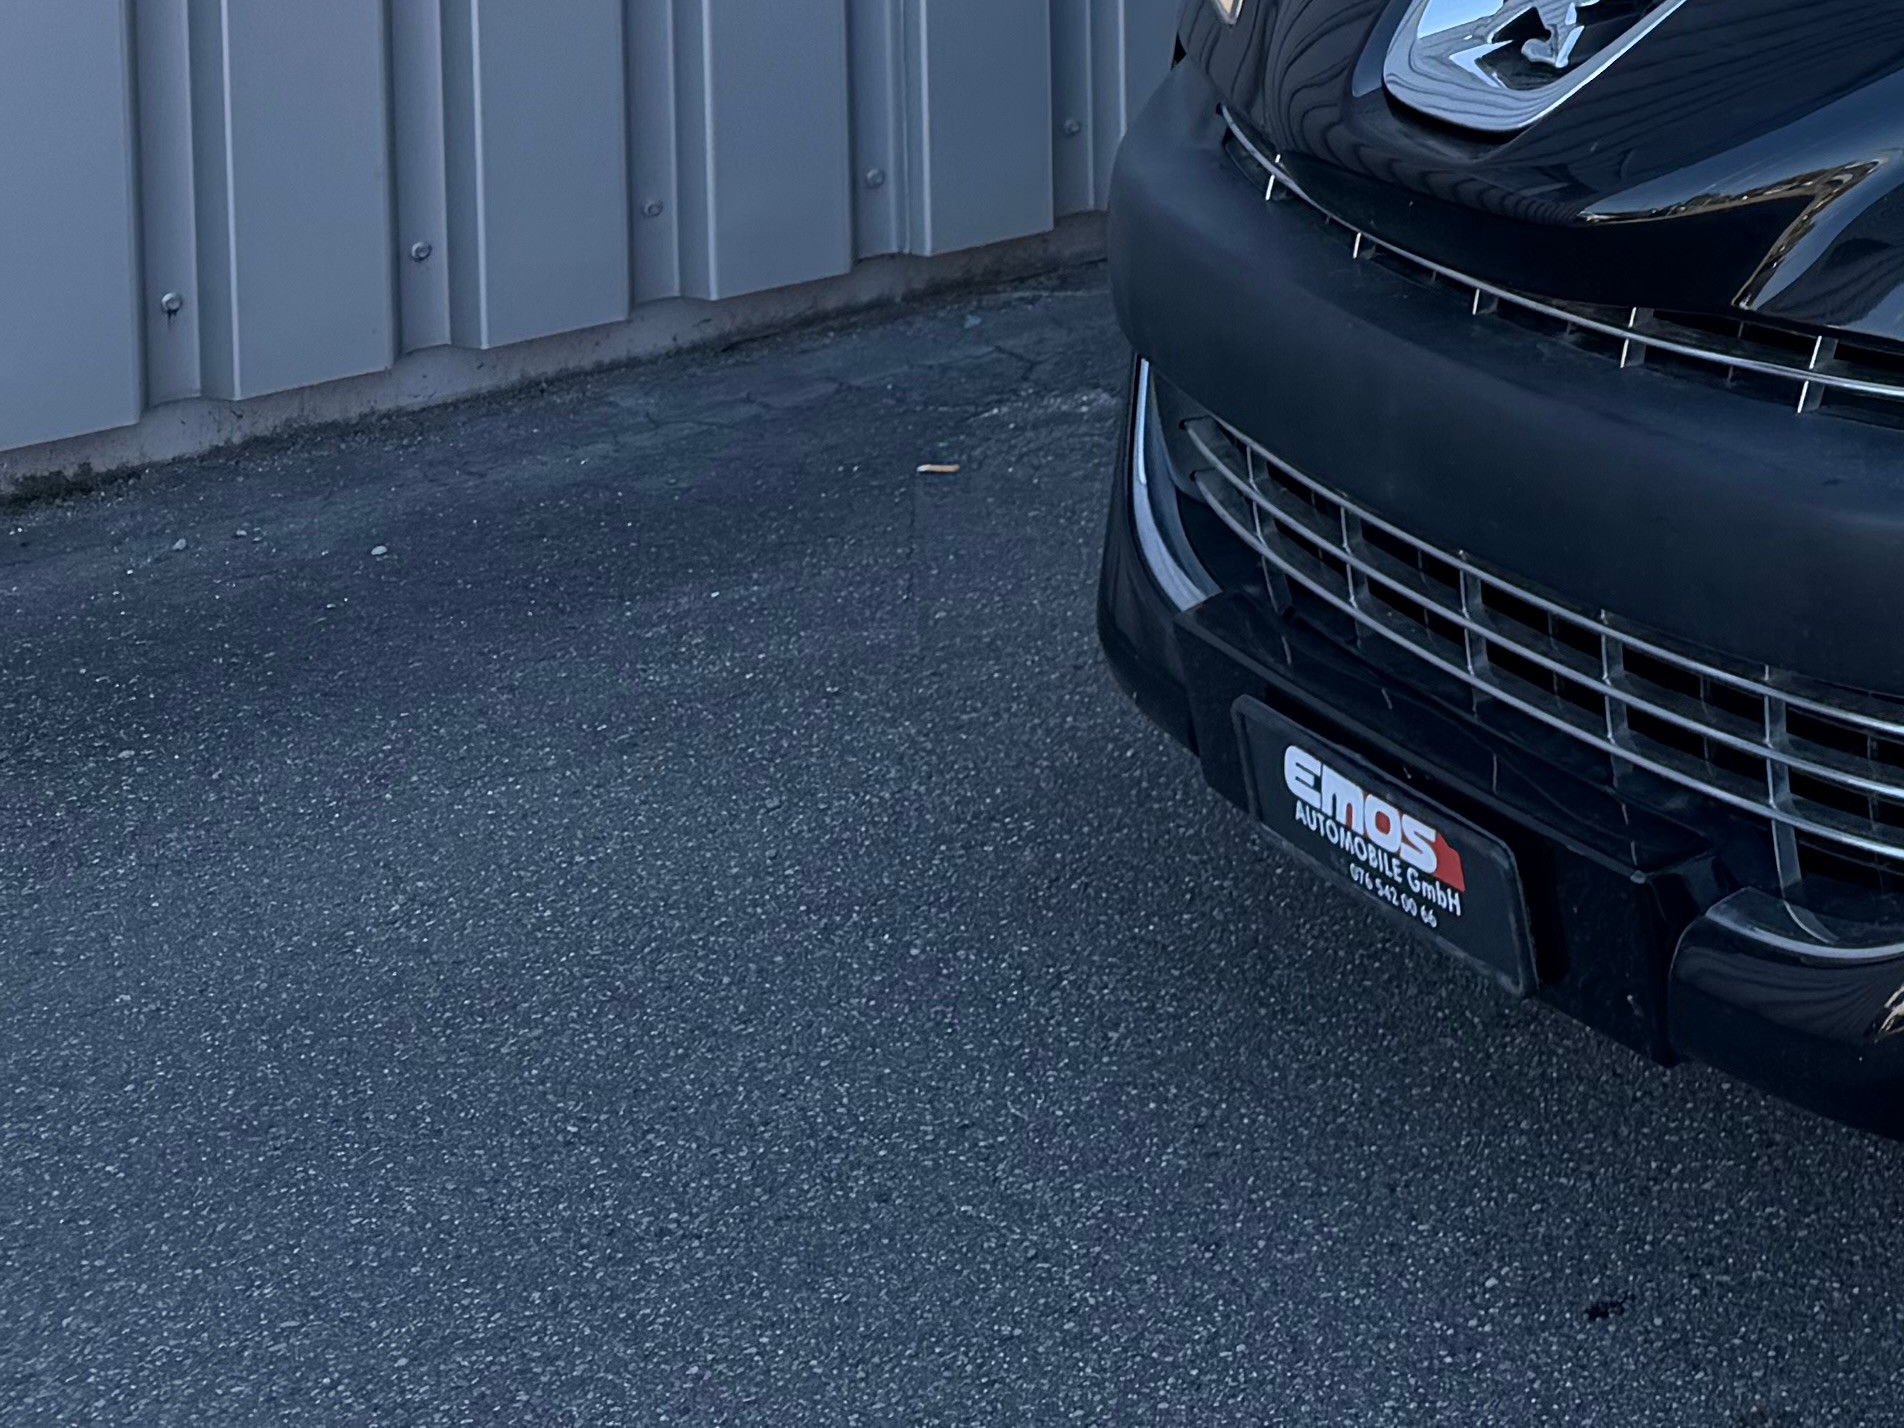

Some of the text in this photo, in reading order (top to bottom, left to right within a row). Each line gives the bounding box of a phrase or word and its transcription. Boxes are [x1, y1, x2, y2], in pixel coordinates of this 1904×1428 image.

[1284, 745, 1438, 874] EMOS
[1295, 800, 1461, 917] AUTOMOBILE GmbH
[1350, 862, 1373, 890] 076
[1400, 893, 1417, 917] 00
